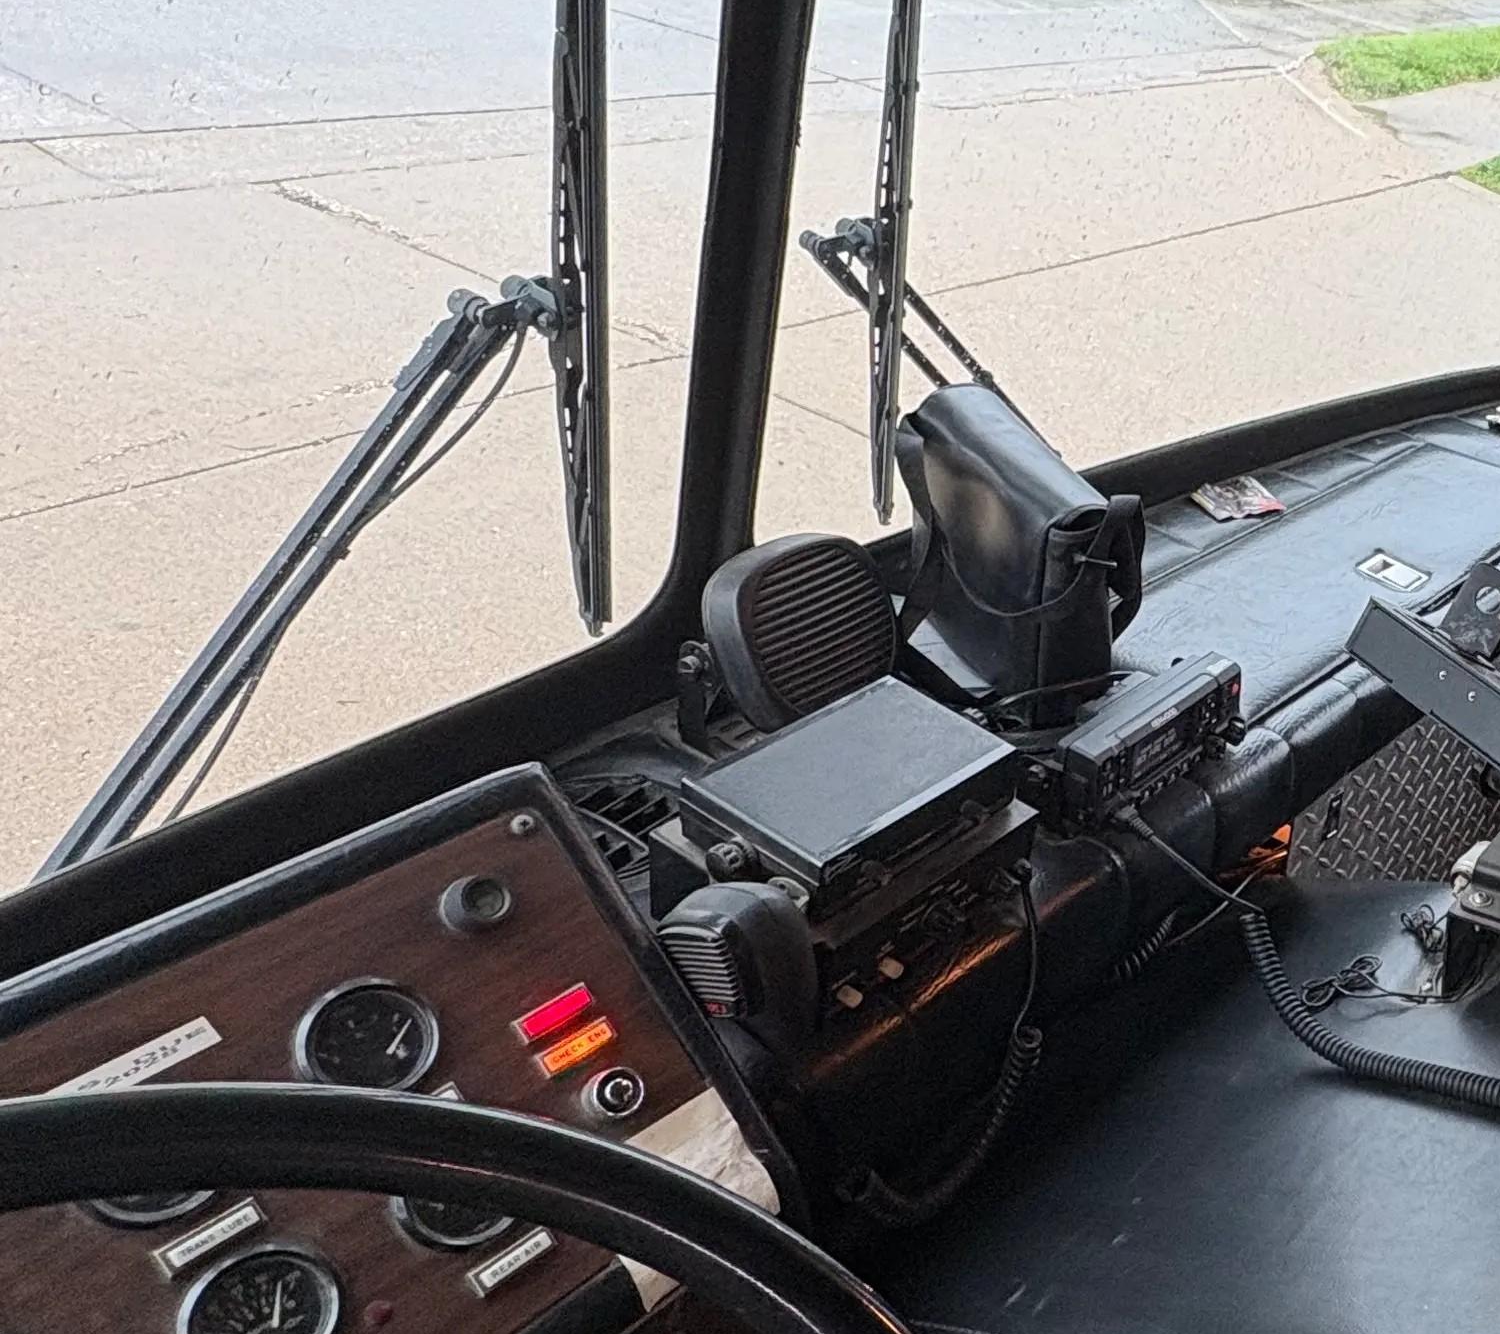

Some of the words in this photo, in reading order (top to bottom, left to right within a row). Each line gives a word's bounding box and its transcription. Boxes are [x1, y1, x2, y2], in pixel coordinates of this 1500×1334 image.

[552, 1042, 584, 1063] CHECK
[490, 1255, 521, 1278] REAR
[524, 1240, 543, 1256] AIR
